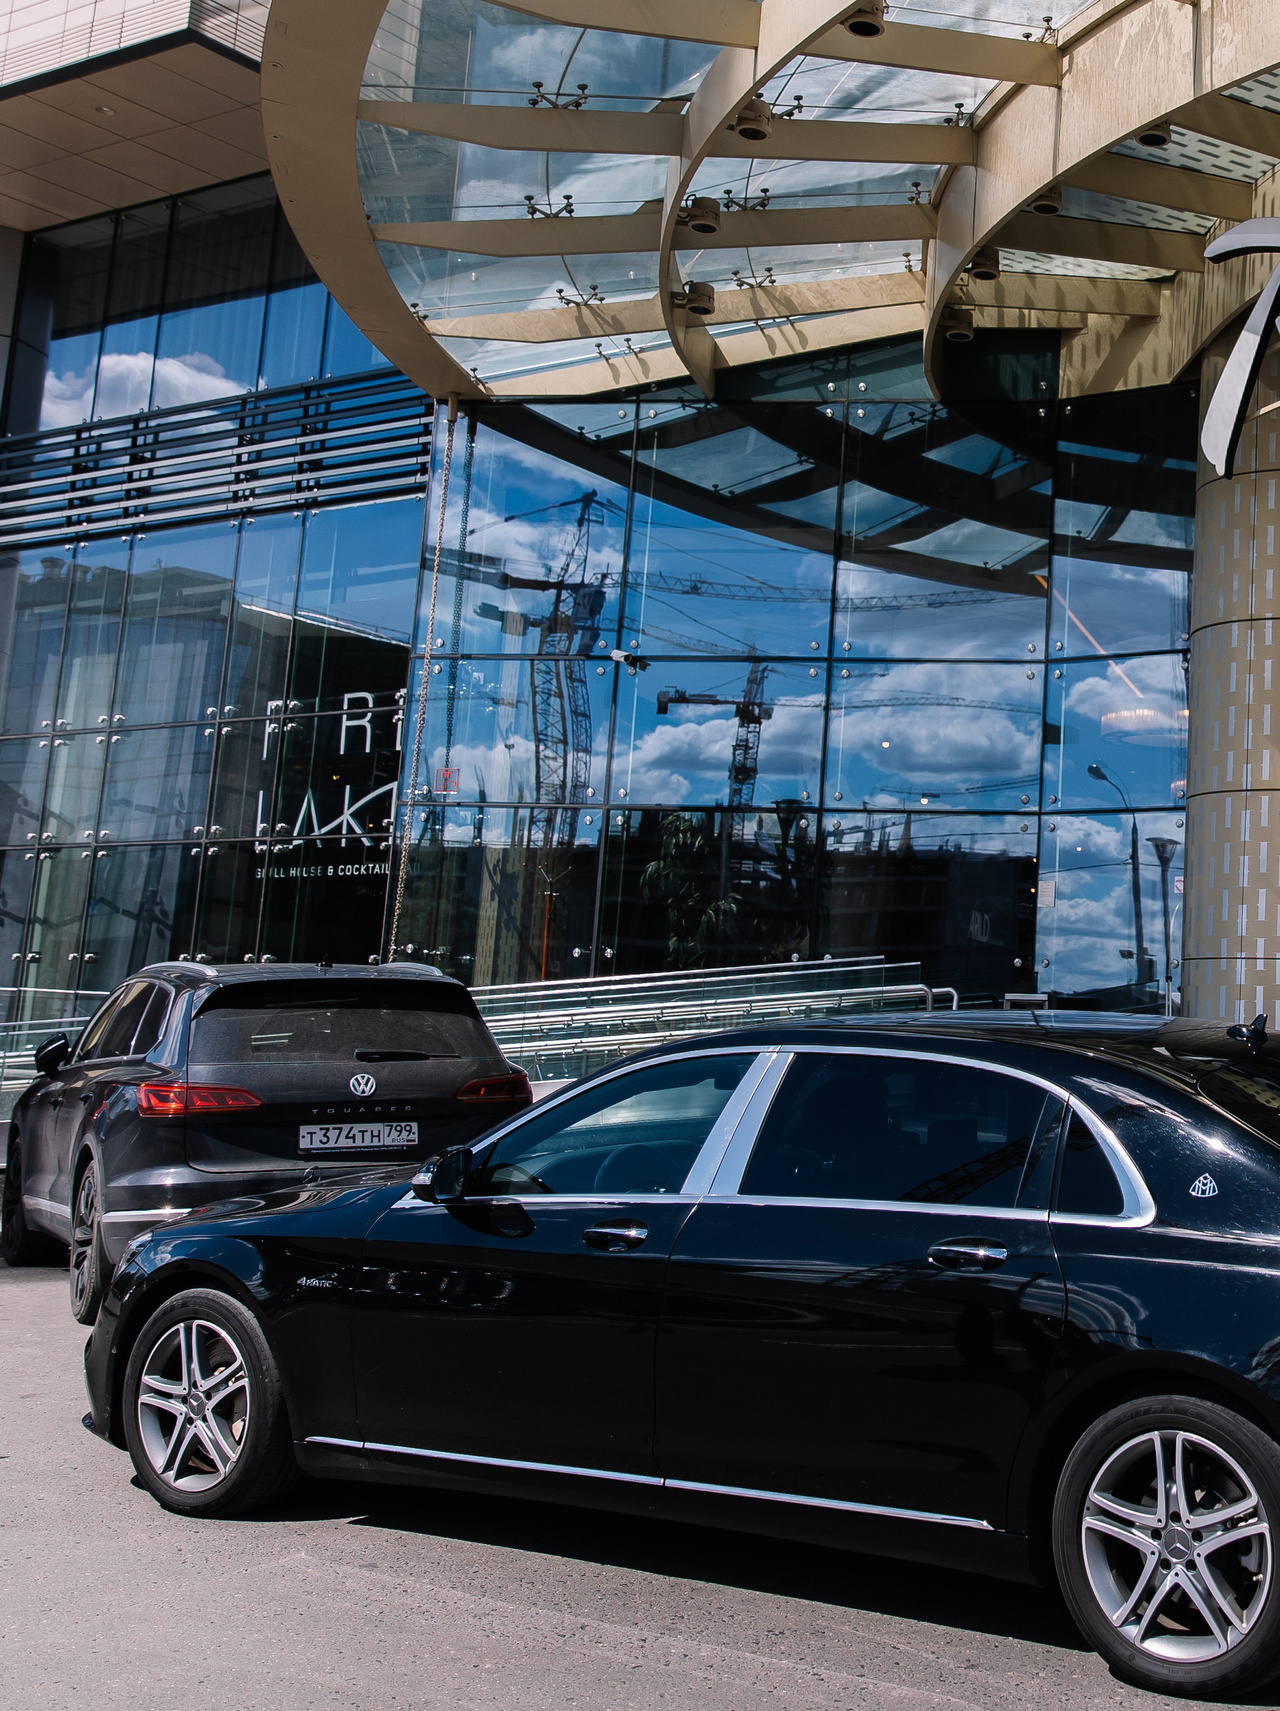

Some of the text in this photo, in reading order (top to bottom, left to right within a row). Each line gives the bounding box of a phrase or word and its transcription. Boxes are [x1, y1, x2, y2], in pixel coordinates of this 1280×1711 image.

[254, 781, 398, 851] LAK
[327, 865, 334, 876] &
[311, 1105, 412, 1115] TOUAREG
[385, 1123, 412, 1138] 799
